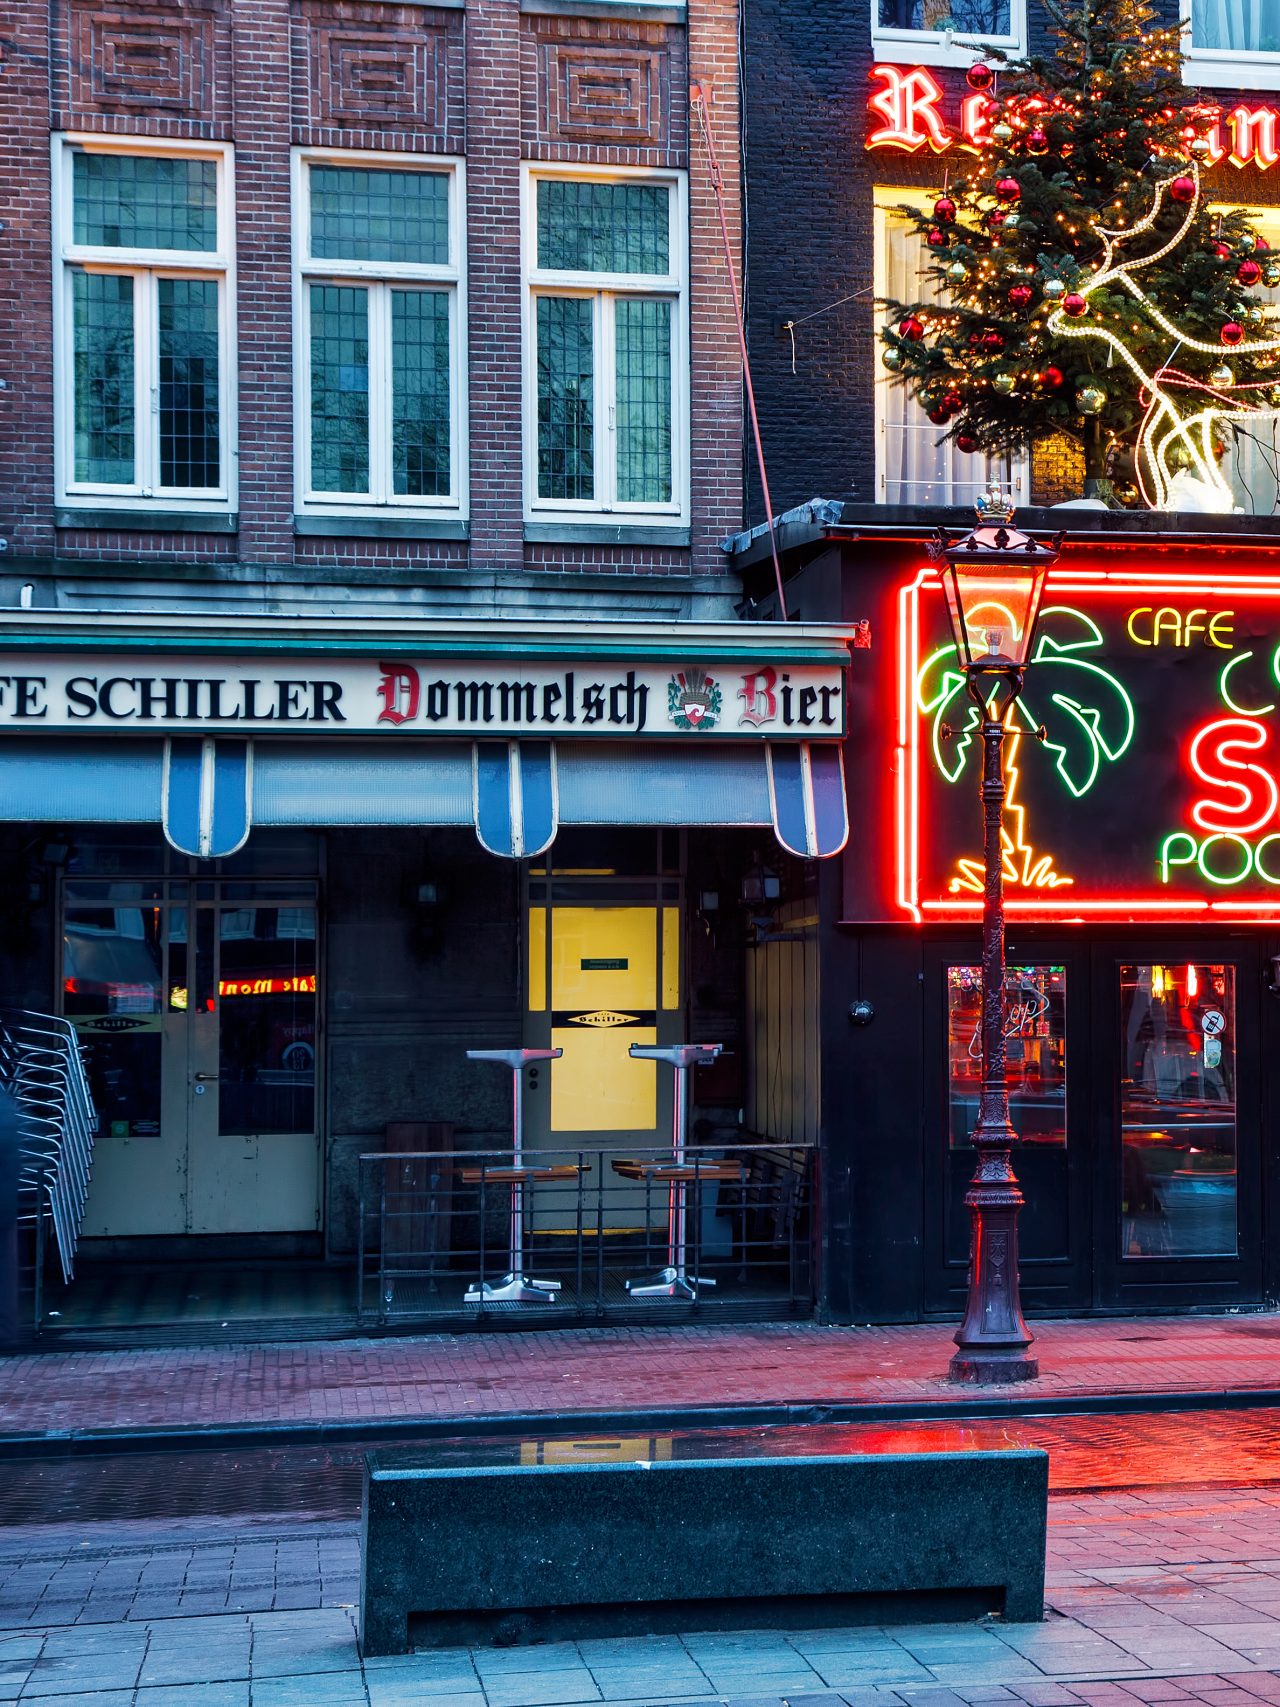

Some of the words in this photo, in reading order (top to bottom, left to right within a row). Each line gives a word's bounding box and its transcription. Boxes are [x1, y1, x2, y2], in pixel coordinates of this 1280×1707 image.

[1128, 607, 1234, 649] CAFE
[65, 676, 347, 722] SCHILLER
[376, 661, 651, 734] Dommelsch
[738, 665, 841, 728] Bier
